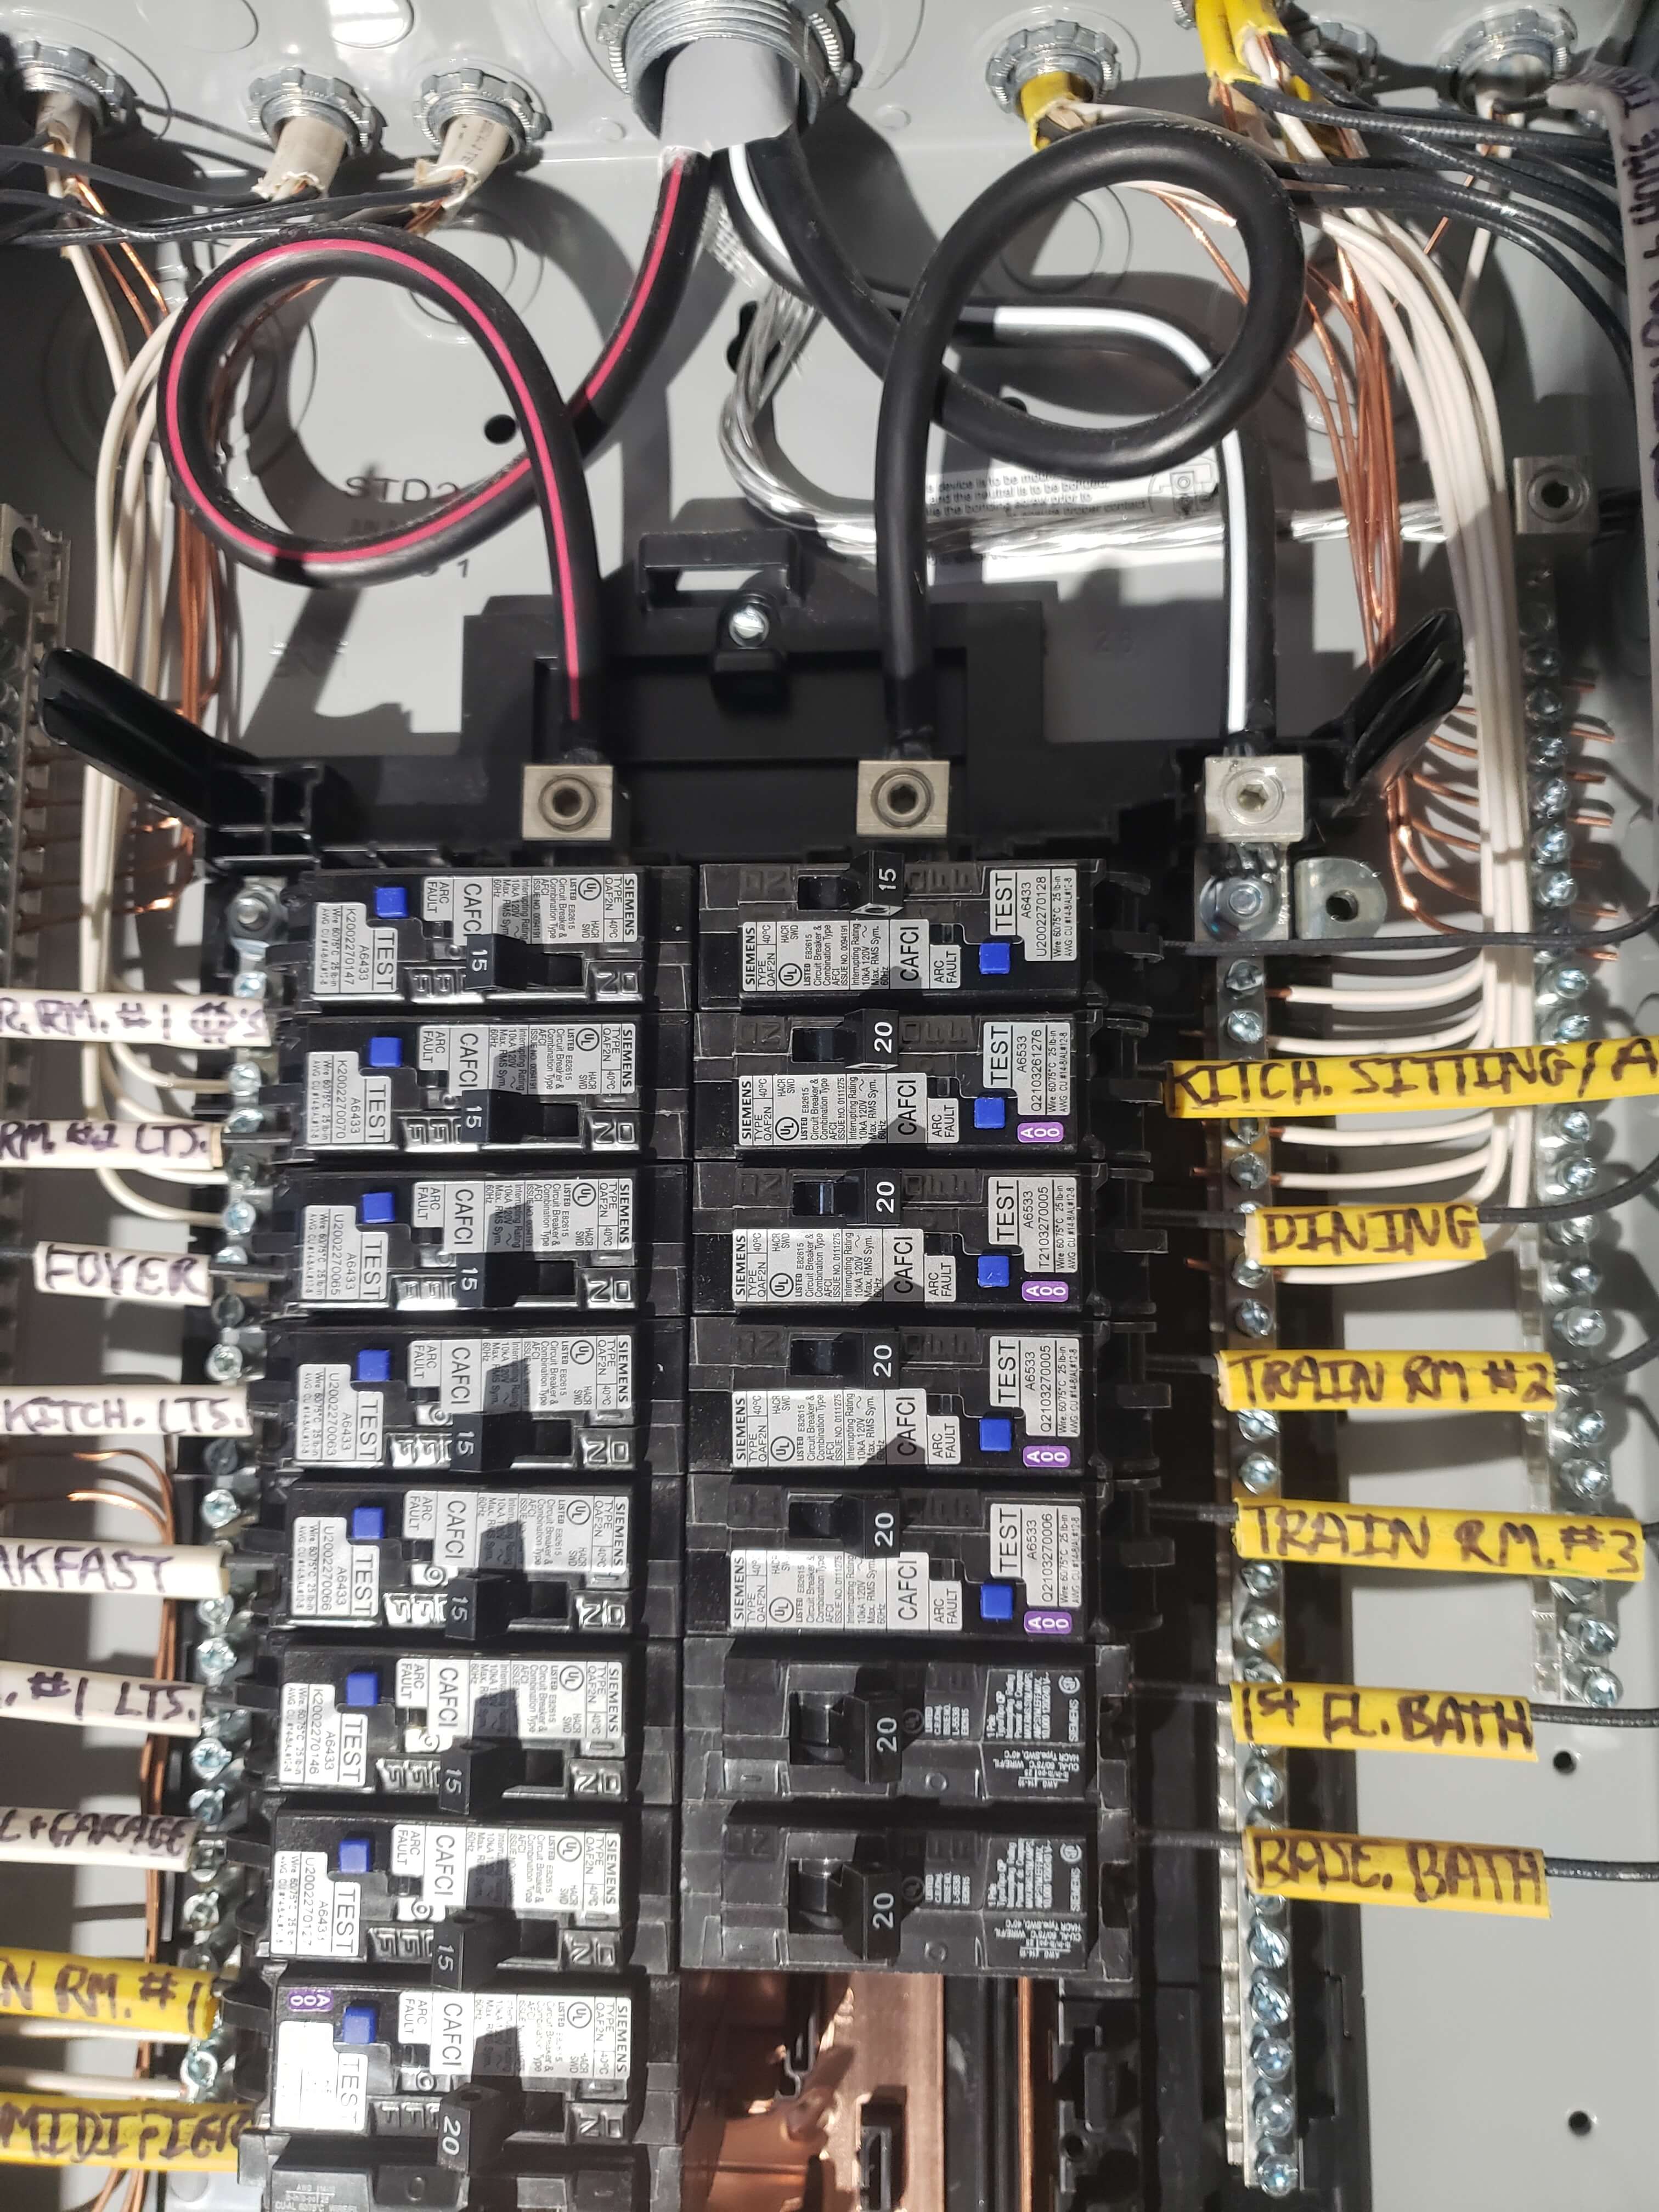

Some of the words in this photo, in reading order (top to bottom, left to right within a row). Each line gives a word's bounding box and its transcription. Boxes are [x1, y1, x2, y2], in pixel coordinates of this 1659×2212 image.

[879, 869, 896, 890] 15
[995, 872, 1013, 932] TEST
[1021, 882, 1032, 918] A6433
[624, 878, 634, 935] SIEMENS
[1035, 877, 1047, 957] U2002270128
[345, 909, 356, 985] K2002270147
[359, 945, 370, 981] A6433
[376, 932, 395, 990] TEST
[472, 949, 487, 971] 15
[746, 928, 755, 985] SIEMENS
[900, 927, 919, 981] CAFCI
[35, 999, 109, 1036] RM.
[874, 1022, 892, 1053] 20
[458, 1033, 478, 1088] CAFCI
[622, 1029, 633, 1087] SIEMENS
[990, 1025, 1009, 1085] TEST
[1016, 1036, 1028, 1073] A6533
[1030, 1030, 1043, 1111] Q2103261276
[336, 1060, 348, 1138] K2002270070
[368, 1084, 387, 1143] TEST
[742, 1081, 752, 1139] SIEMENS
[897, 1080, 917, 1136] CAFCI
[1166, 1061, 1333, 1114] KITCH.
[350, 1097, 362, 1133] A6433
[466, 1106, 482, 1128] 15
[453, 1189, 474, 1246] CAFCI
[619, 1183, 630, 1243] SIEMENS
[876, 1182, 894, 1212] 20
[996, 1181, 1014, 1241] TEST
[1023, 1190, 1034, 1228] A6533
[1056, 1203, 1063, 1212] 25
[771, 1233, 781, 1252] HACR
[781, 1233, 790, 1249] SWD
[814, 1232, 825, 1250] Type
[844, 1232, 854, 1255] Rating
[864, 1235, 874, 1255] Sym.
[1038, 1187, 1049, 1268] T2103270005
[1068, 1238, 1075, 1248] CU
[1263, 1204, 1478, 1256] DINING
[46, 1244, 208, 1296] FOYER
[345, 1252, 357, 1290] A6433
[363, 1240, 382, 1301] TEST
[462, 1267, 478, 1290] 15
[736, 1235, 746, 1295] SIEMENS
[757, 1262, 766, 1297] QAF2N
[805, 1241, 814, 1271] Breaker
[814, 1252, 823, 1297] Combination
[844, 1257, 854, 1297] Interrupting
[864, 1257, 872, 1276] RMS
[893, 1237, 913, 1294] CAFCI
[941, 1262, 951, 1296] FAULT
[1068, 1252, 1076, 1269] AWG
[748, 1270, 757, 1298] TYPE
[805, 1273, 814, 1297] Circuit
[864, 1279, 872, 1297] Max.
[928, 1272, 939, 1296] ARC
[450, 1347, 471, 1405] CAFCI
[618, 1341, 628, 1402] SIEMENS
[873, 1345, 892, 1377] 20
[997, 1340, 1017, 1403] TEST
[1025, 1351, 1036, 1391] A6533
[1226, 1353, 1384, 1407] TRAIN
[1482, 1359, 1555, 1404] #2
[1040, 1345, 1052, 1432] Q2103270005
[160, 1398, 245, 1434] LTS.
[359, 1399, 379, 1462] TEST
[735, 1398, 747, 1460] SIEMENS
[895, 1397, 917, 1456] CAFCI
[458, 1432, 474, 1454] 15
[444, 1499, 467, 1560] CAFCI
[613, 1502, 625, 1566] SIEMENS
[874, 1513, 893, 1546] 20
[999, 1508, 1018, 1573] TEST
[1026, 1520, 1037, 1560] A6533
[1244, 1504, 1429, 1560] TRAIN
[1454, 1519, 1556, 1571] RM.
[1560, 1525, 1639, 1573] #3
[1041, 1513, 1054, 1602] Q2103270006
[354, 1553, 374, 1617] TEST
[452, 1596, 469, 1621] 15
[734, 1556, 744, 1620] SIEMENS
[898, 1560, 918, 1621] CAFCI
[27, 1671, 89, 1720] #1
[115, 1681, 195, 1722] LTS.
[437, 1667, 459, 1728] CAFCI
[608, 1668, 618, 1732] SIEMENS
[1069, 1699, 1080, 1742] SIEMENS
[877, 1717, 896, 1752] 20
[1397, 1695, 1533, 1752] BATH
[342, 1718, 364, 1783] TEST
[445, 1769, 462, 1793] 15
[433, 1833, 455, 1897] CAFCI
[605, 1839, 617, 1904] SIEMENS
[1070, 1867, 1081, 1912] SIEMENS
[1407, 1842, 1542, 1904] BATH
[335, 1886, 357, 1954] TEST
[872, 1893, 893, 1929] 20
[438, 1945, 454, 1971] 15
[54, 1962, 132, 2019] RM.
[138, 1972, 203, 2034] #1
[441, 2002, 463, 2067] CAFCI
[616, 2004, 628, 2072] SIEMENS
[442, 2115, 461, 2155] 20
